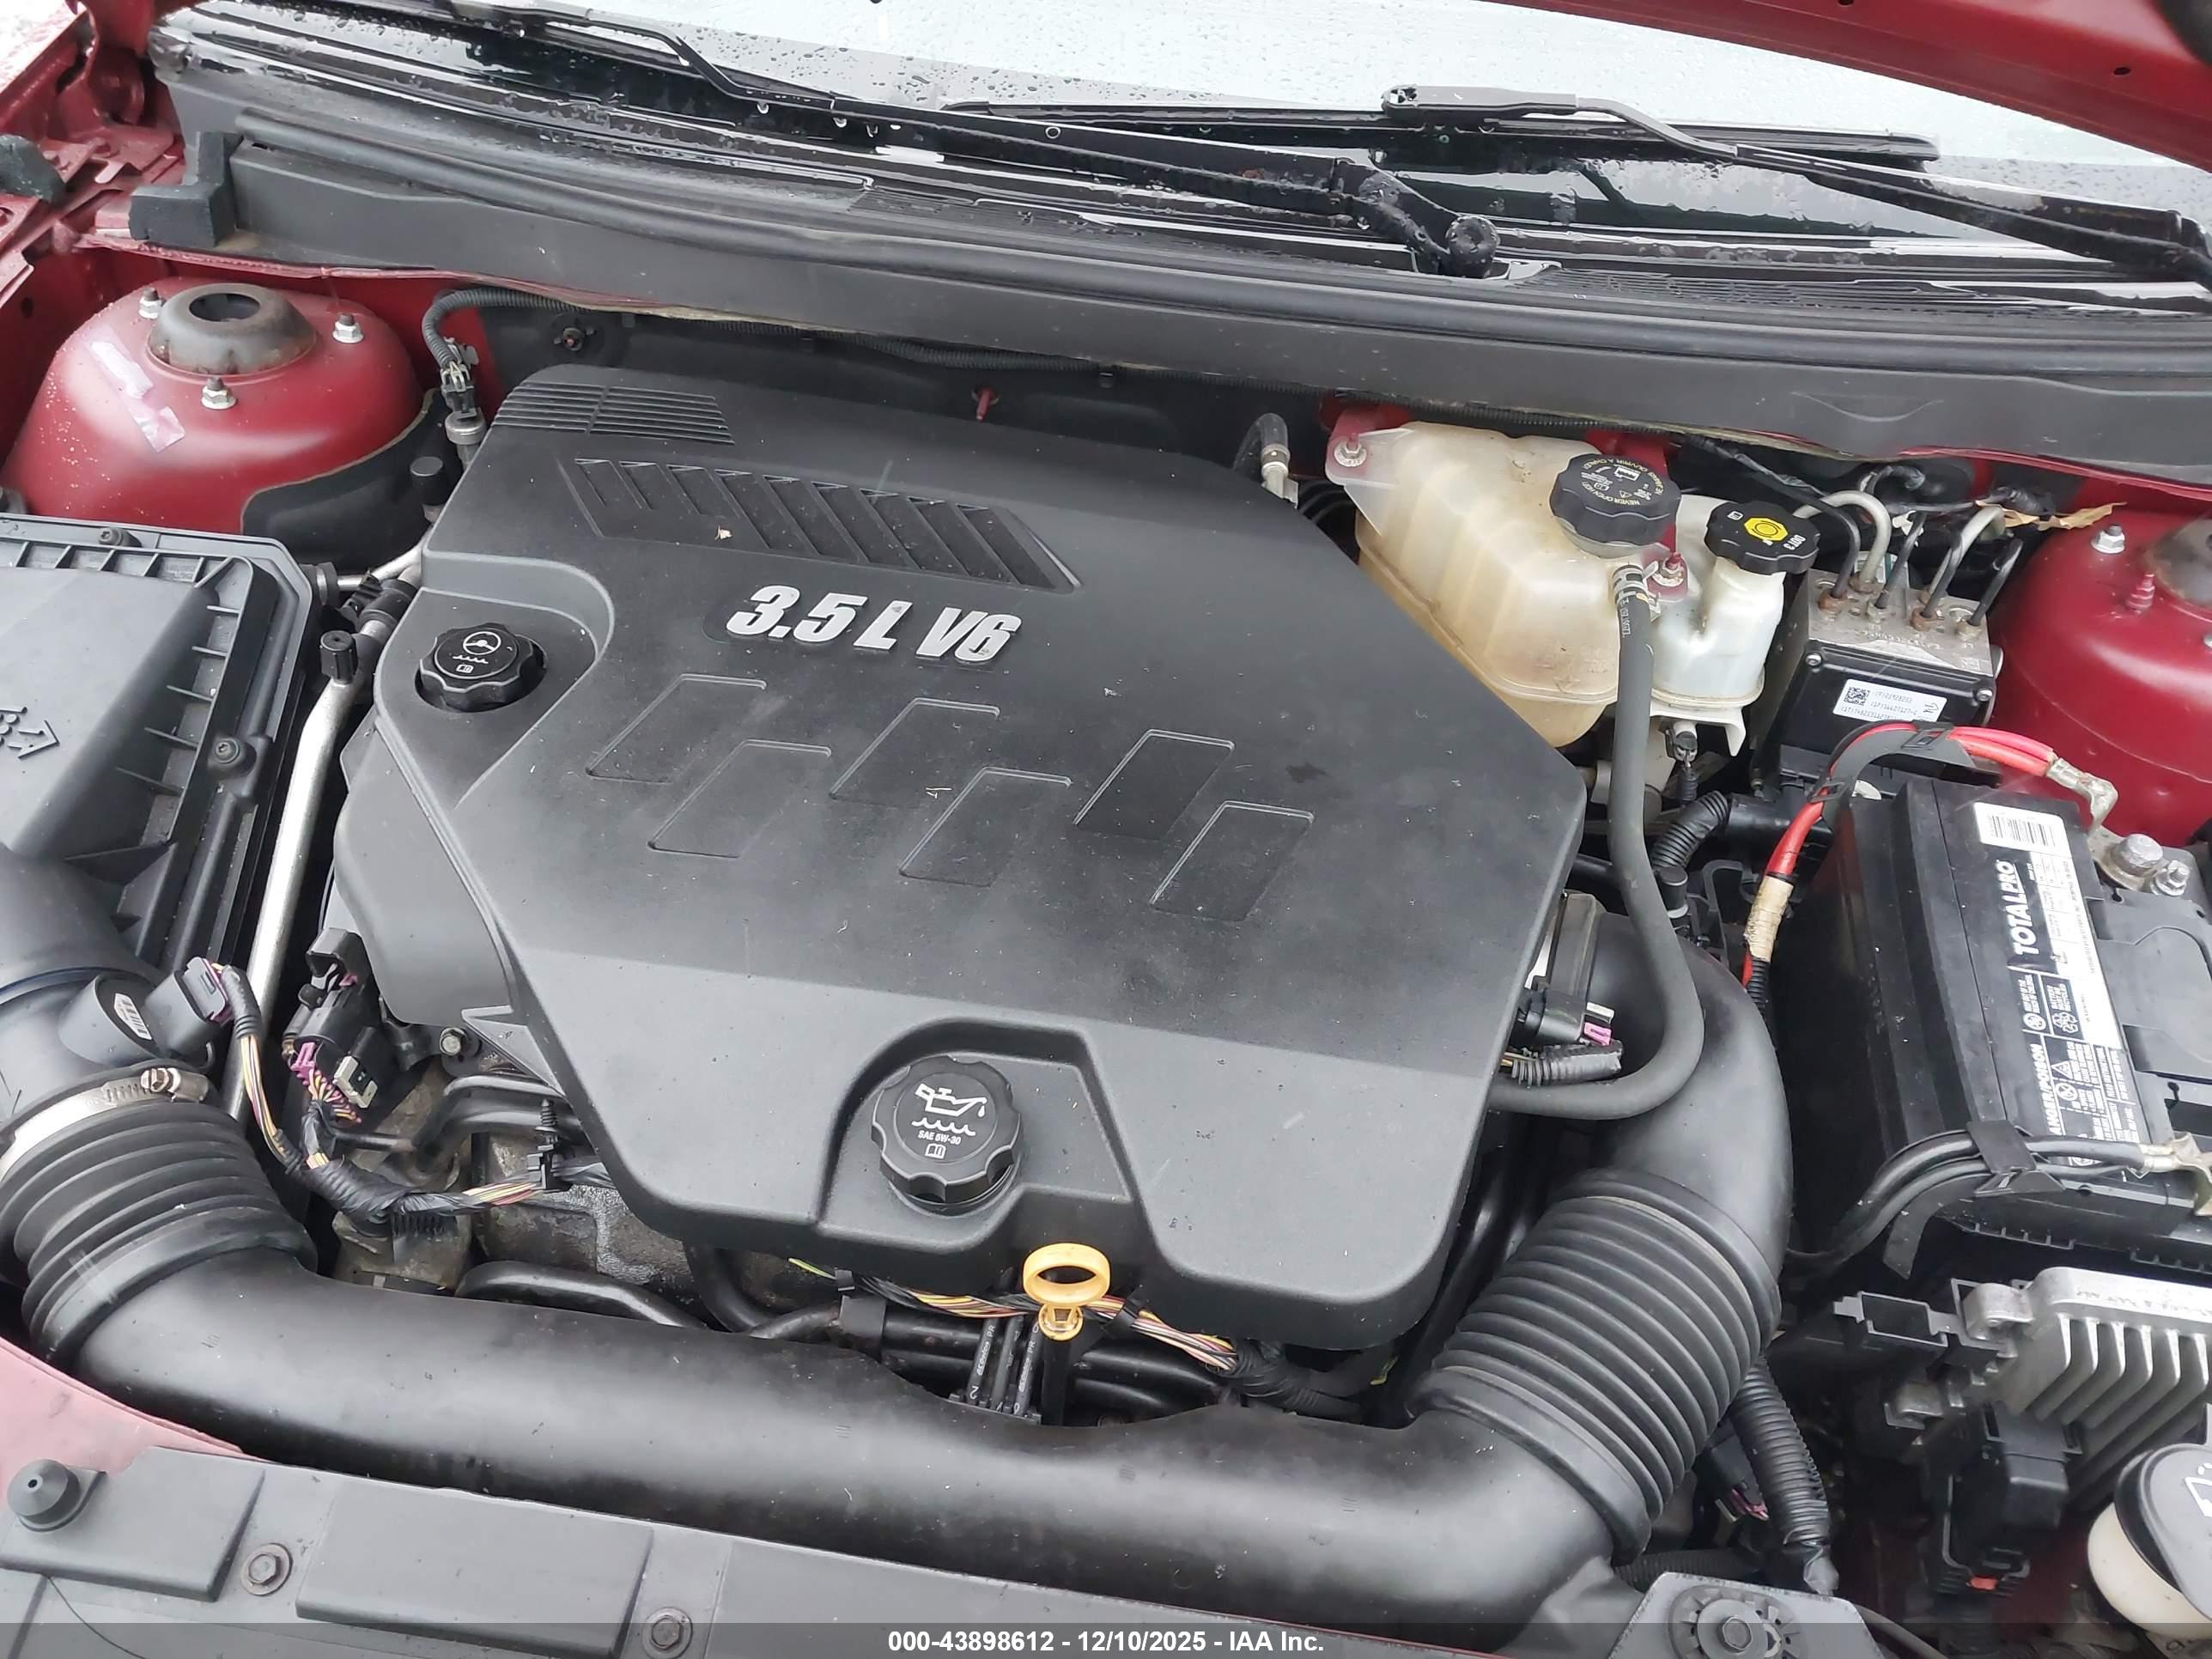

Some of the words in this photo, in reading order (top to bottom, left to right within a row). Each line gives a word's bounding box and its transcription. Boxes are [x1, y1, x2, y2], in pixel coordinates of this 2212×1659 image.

[1593, 490, 1614, 502] OPEN
[916, 606, 1022, 662] V6
[2047, 985, 2058, 1009] BATTERY
[2060, 983, 2071, 1012] RECYCLED
[2030, 1043, 2062, 1135] ANGER/POISON
[918, 1129, 935, 1140] SAE
[935, 1133, 962, 1146] 5W-30
[987, 1325, 995, 1338] PR
[1027, 1340, 1036, 1354] PR
